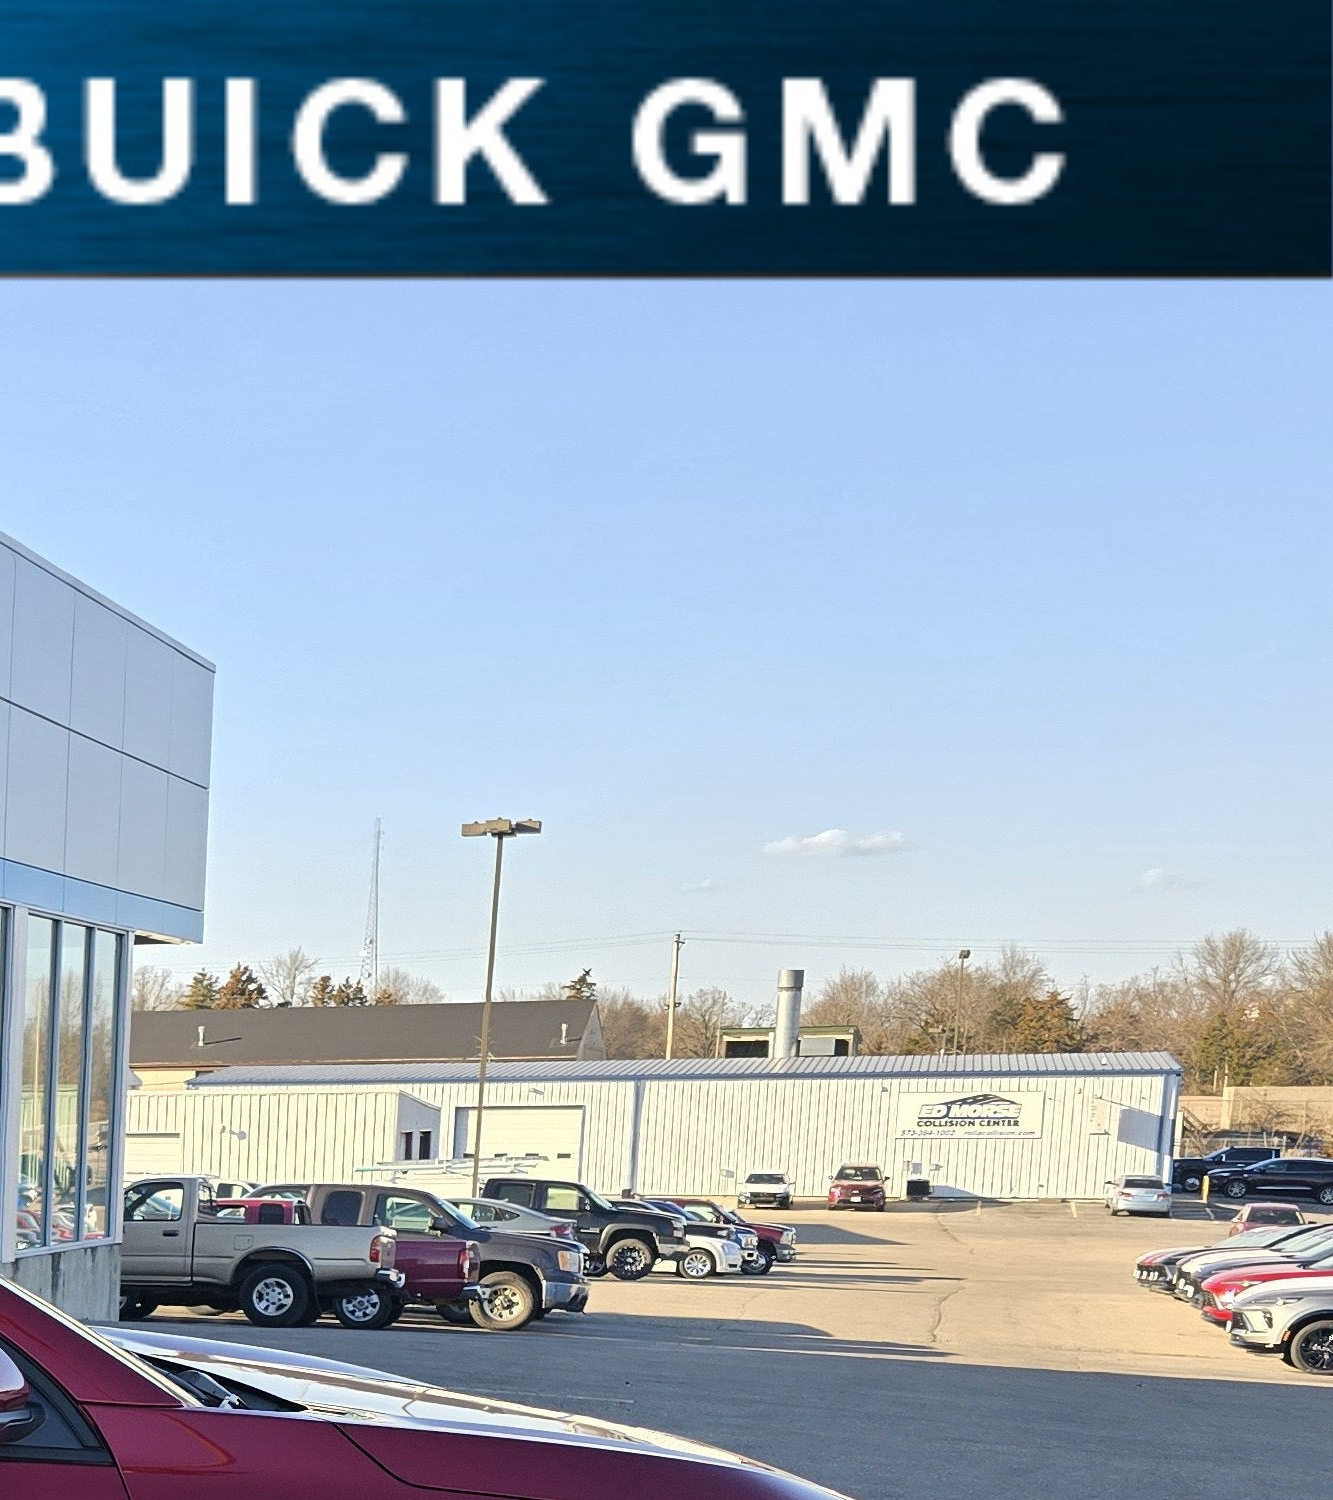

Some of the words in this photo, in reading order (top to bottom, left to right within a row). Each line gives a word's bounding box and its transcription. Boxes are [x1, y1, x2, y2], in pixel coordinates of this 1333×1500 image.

[918, 1103, 949, 1119] ED
[948, 1103, 1023, 1120] MORSE
[916, 1119, 976, 1128] COLLISION
[978, 1119, 1020, 1127] CENTER
